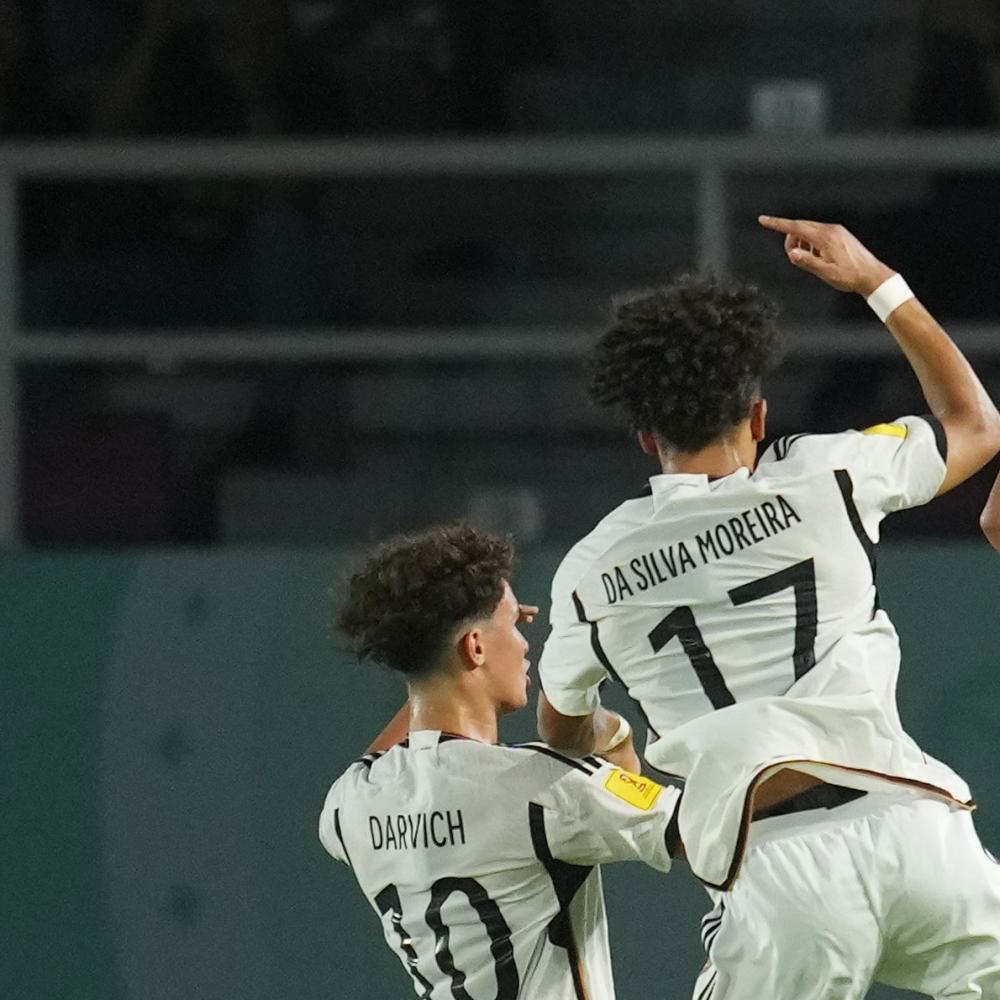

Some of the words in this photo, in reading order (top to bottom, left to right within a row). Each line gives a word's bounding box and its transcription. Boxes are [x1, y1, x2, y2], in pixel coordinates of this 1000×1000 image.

[601, 566, 634, 605] DA
[630, 541, 697, 591] SILVA
[695, 494, 802, 565] MOREIRA
[648, 557, 818, 710] 17
[369, 809, 466, 850] DARVICH
